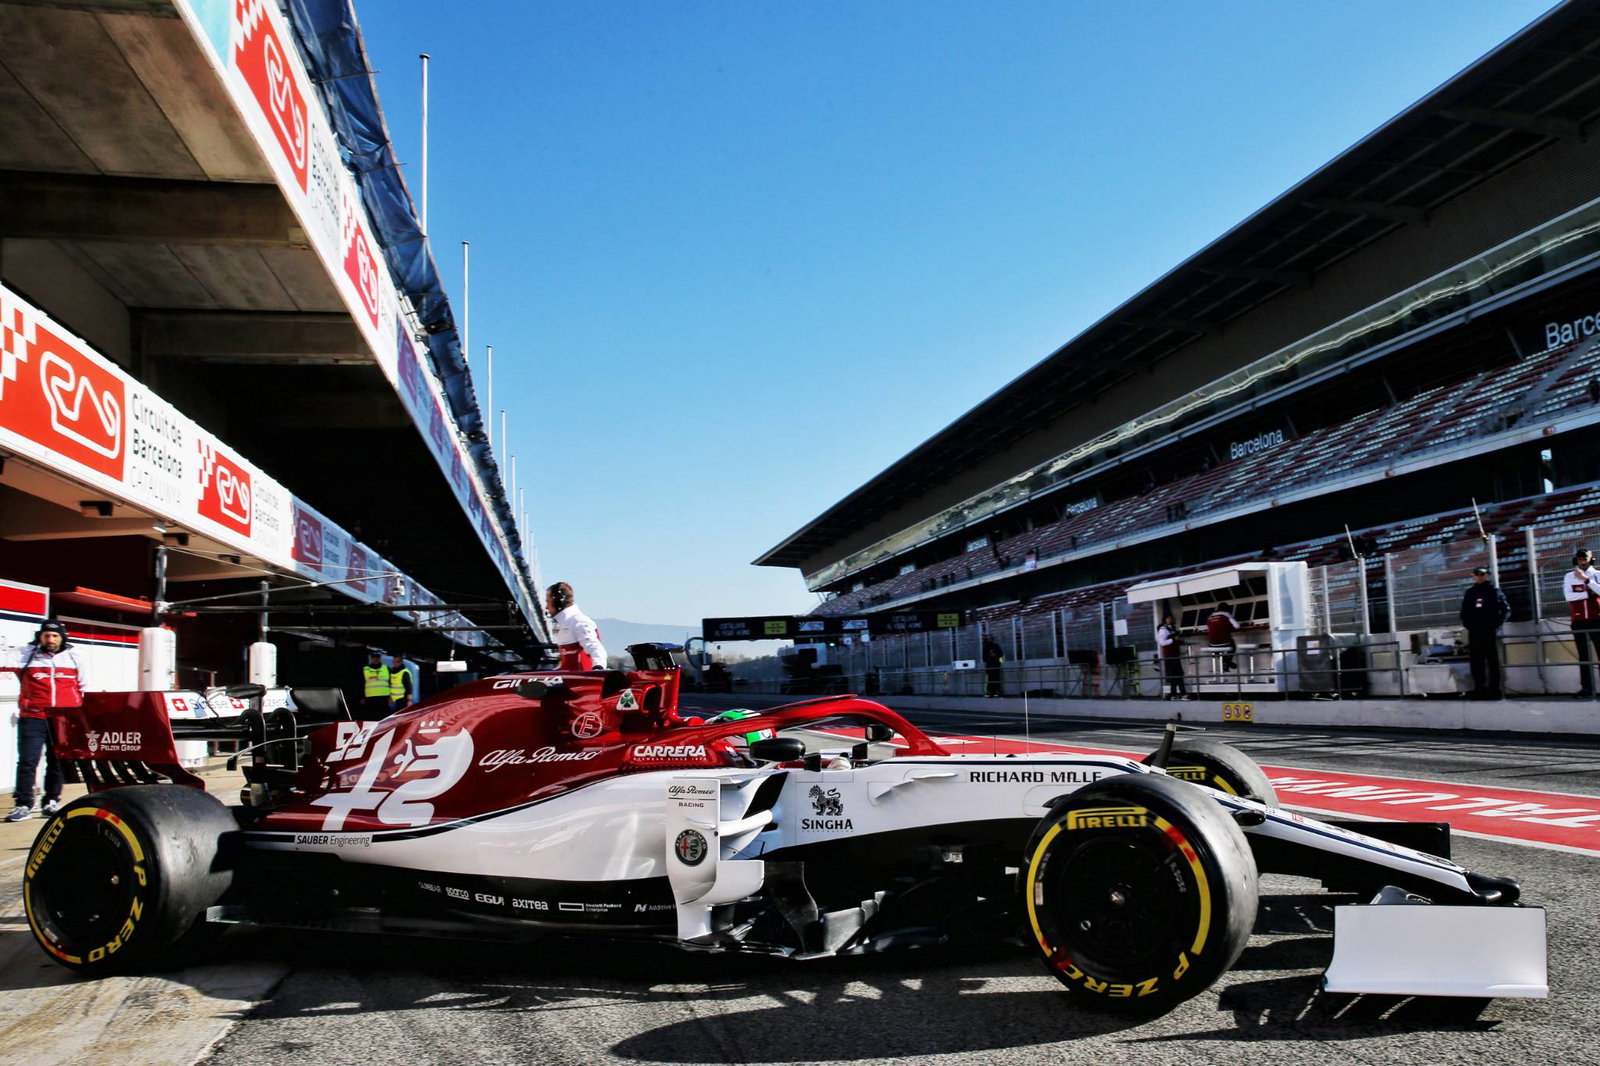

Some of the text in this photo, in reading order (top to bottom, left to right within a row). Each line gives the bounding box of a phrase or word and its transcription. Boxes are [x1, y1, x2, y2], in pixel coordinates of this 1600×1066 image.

[132, 393, 182, 447] Circuit de
[133, 428, 182, 479] Barcelona
[1230, 429, 1284, 460] Barcelona
[100, 731, 142, 745] ADLER
[478, 746, 603, 773] Alfa Romeo
[633, 745, 707, 757] CARRERA
[969, 771, 1102, 783] RICHARD MILLE
[1166, 766, 1207, 780] ELLI
[668, 785, 715, 796] Alfa Romeo
[801, 818, 854, 830] SINGHA
[1067, 806, 1150, 831] PIRELLI
[26, 816, 66, 880] PIRELLI
[297, 834, 370, 848] SAUBER Engineering
[88, 865, 147, 963] P ZERO
[1062, 951, 1190, 998] P ZERO
